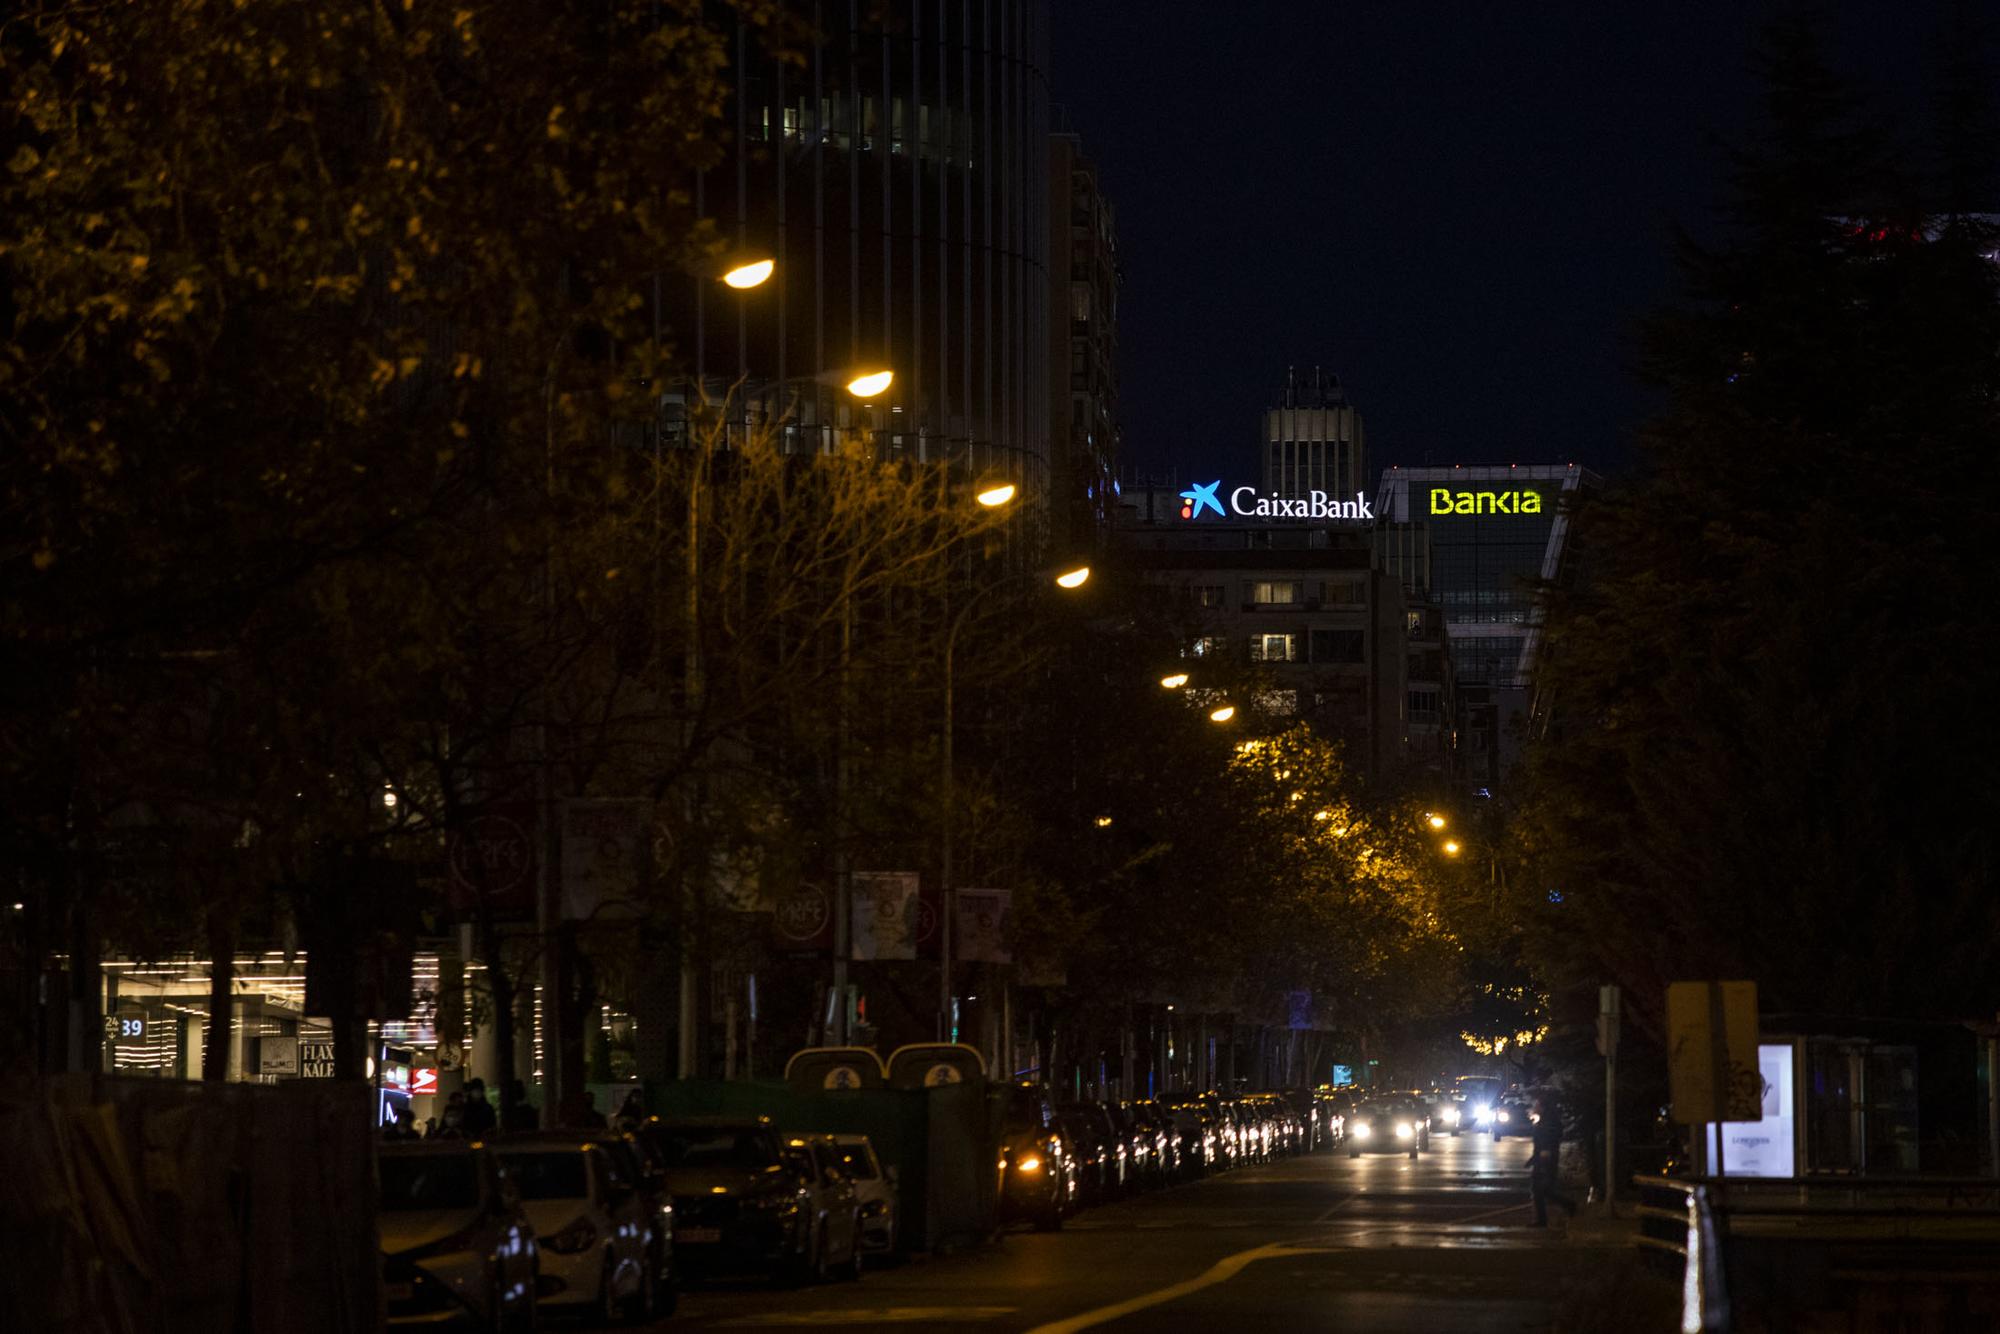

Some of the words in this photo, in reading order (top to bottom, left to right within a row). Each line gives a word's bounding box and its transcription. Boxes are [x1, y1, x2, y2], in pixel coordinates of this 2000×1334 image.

[1231, 486, 1374, 519] CaixaBank
[1430, 488, 1541, 515] Bankia
[303, 1045, 334, 1060] FLAX
[303, 1062, 335, 1078] KALE
